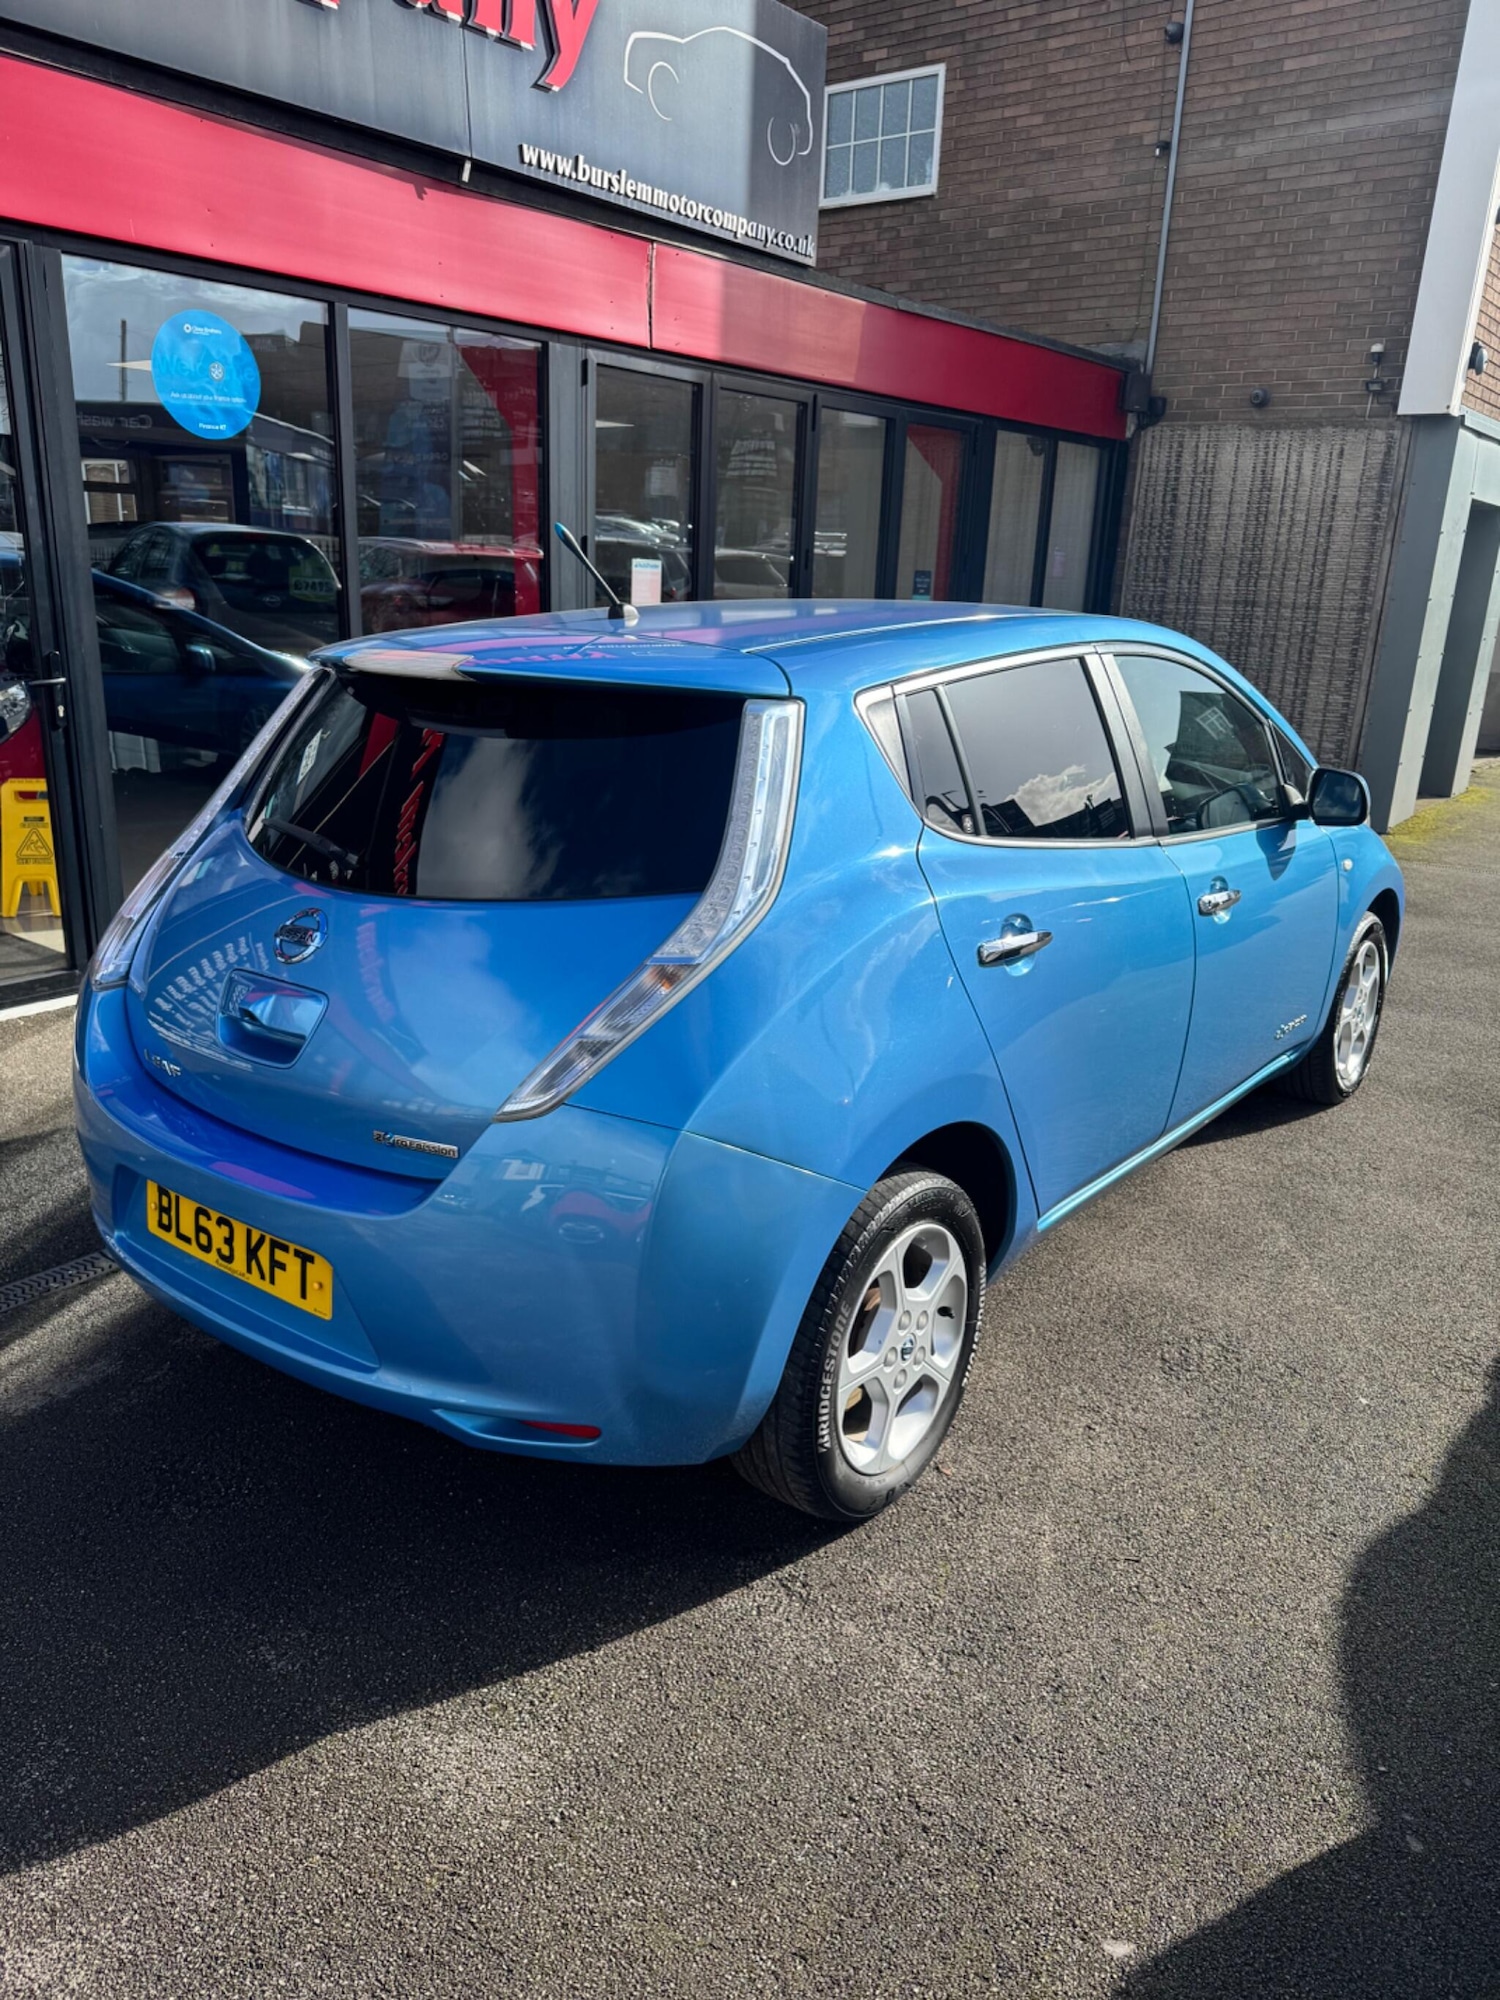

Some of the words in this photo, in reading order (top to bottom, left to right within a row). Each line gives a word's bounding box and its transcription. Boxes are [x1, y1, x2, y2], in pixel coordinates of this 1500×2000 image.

[519, 143, 815, 258] www.burslemmotorcompany.co.uk
[144, 1048, 182, 1077] LEAF
[156, 1184, 235, 1265] BL63
[246, 1227, 315, 1301] KFT
[817, 1302, 851, 1454] BRIDGESTONE
